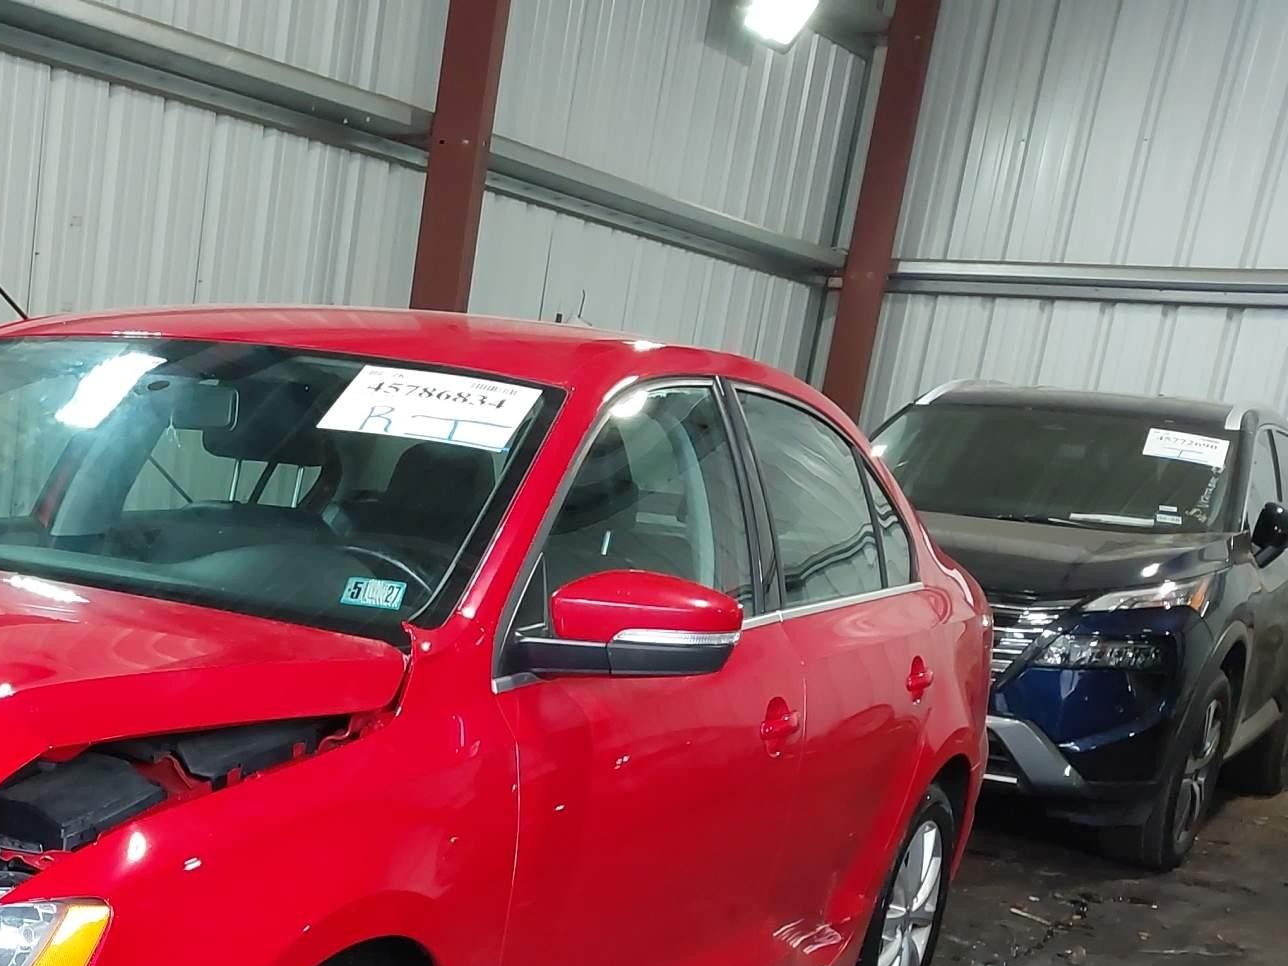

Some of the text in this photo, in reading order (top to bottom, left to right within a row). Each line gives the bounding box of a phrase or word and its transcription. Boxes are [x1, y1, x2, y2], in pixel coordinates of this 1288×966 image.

[367, 381, 507, 409] 45786834
[358, 405, 395, 432] R
[350, 581, 364, 599] 5
[384, 585, 401, 604] 27
